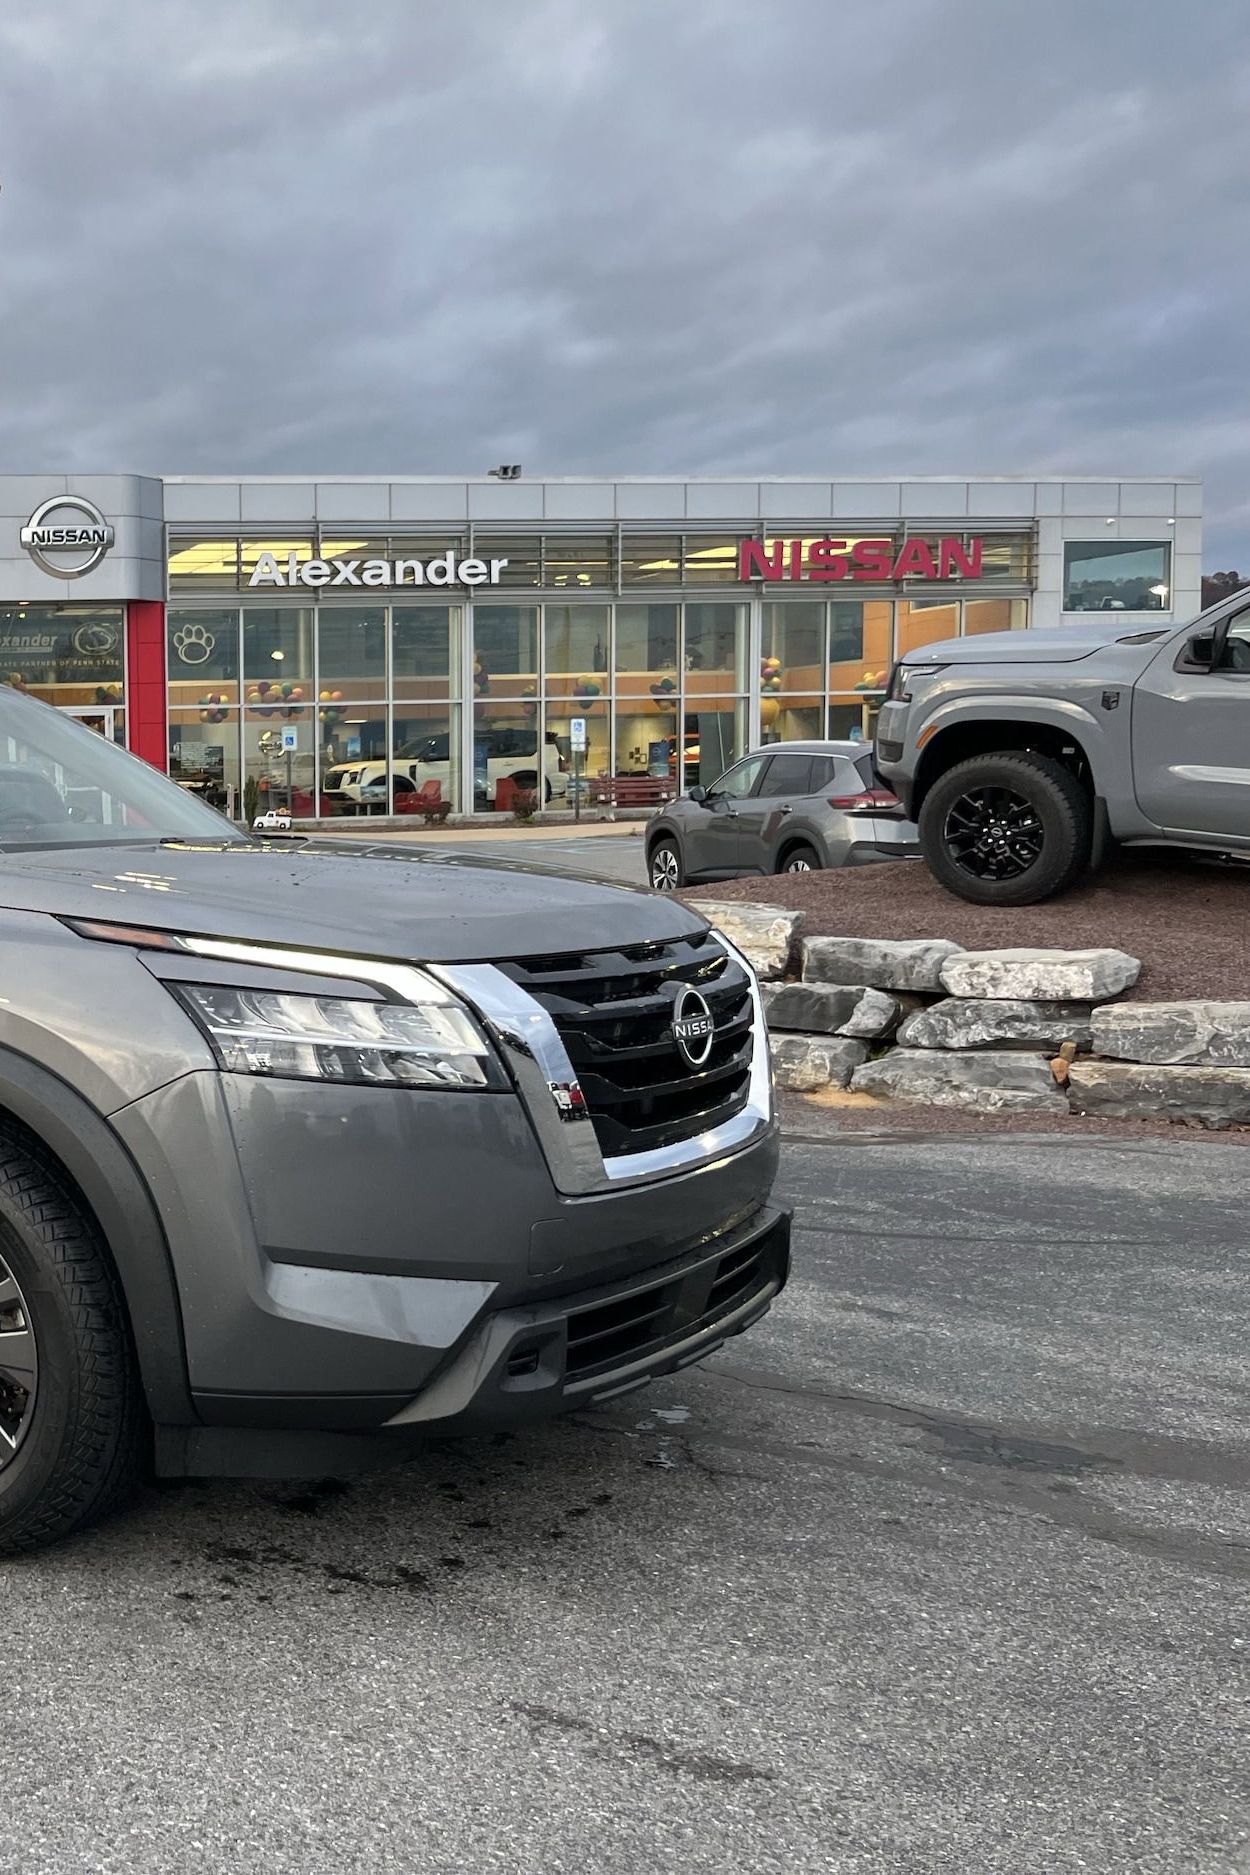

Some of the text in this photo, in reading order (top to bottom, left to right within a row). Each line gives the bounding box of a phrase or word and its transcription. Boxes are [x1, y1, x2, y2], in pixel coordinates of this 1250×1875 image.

[31, 529, 106, 545] NISSAN
[248, 550, 508, 587] Alexander
[739, 537, 983, 581] NISSAN
